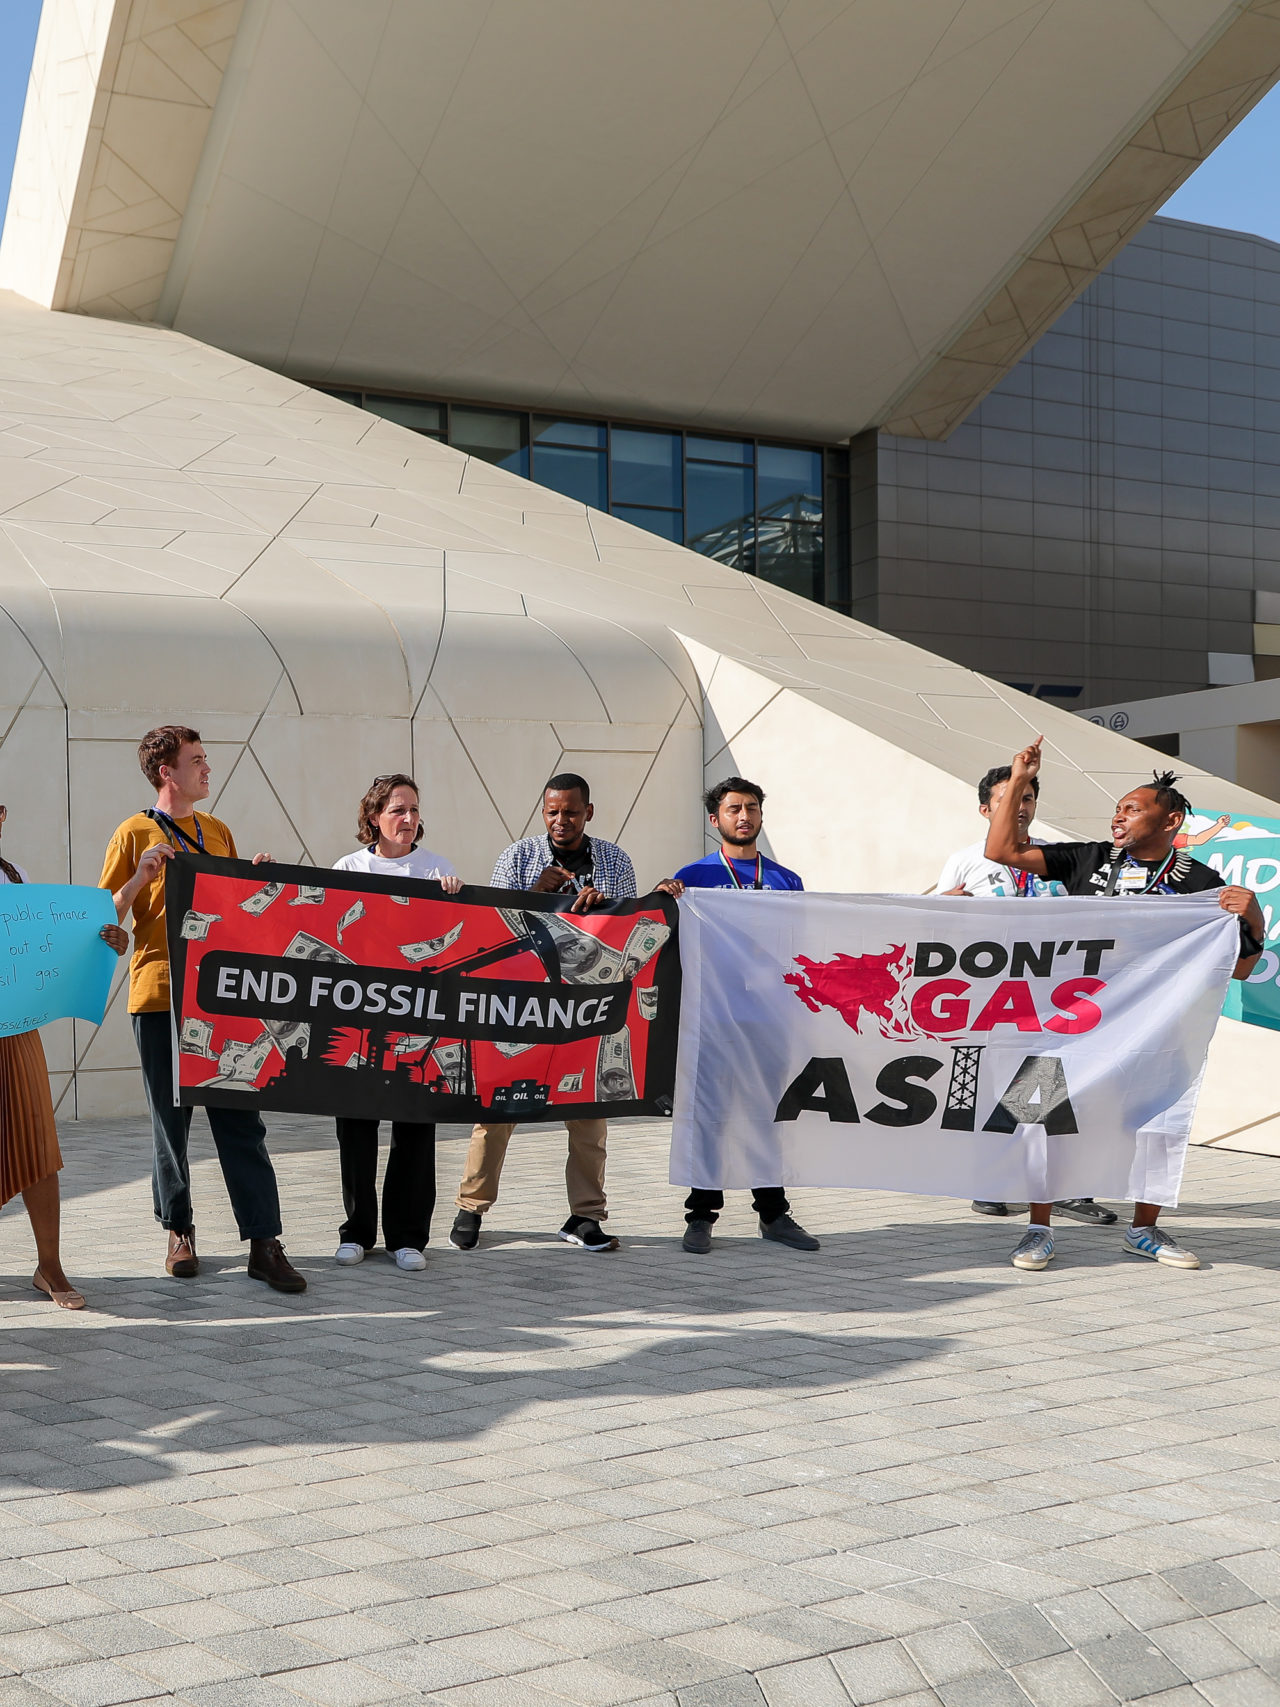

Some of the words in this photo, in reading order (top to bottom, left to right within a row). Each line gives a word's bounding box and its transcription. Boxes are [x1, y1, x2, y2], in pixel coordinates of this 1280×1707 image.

[0, 903, 45, 936] public
[49, 901, 89, 926] finance
[9, 940, 30, 956] out
[39, 933, 54, 953] of
[912, 938, 1117, 979] DON'T
[35, 966, 60, 990] gas
[215, 967, 298, 1008] END
[308, 976, 447, 1022] FOSSIL
[457, 991, 615, 1030] FINANCE
[910, 976, 1110, 1036] GAS
[512, 1092, 529, 1100] OIL
[773, 1045, 1080, 1137] ASIA
